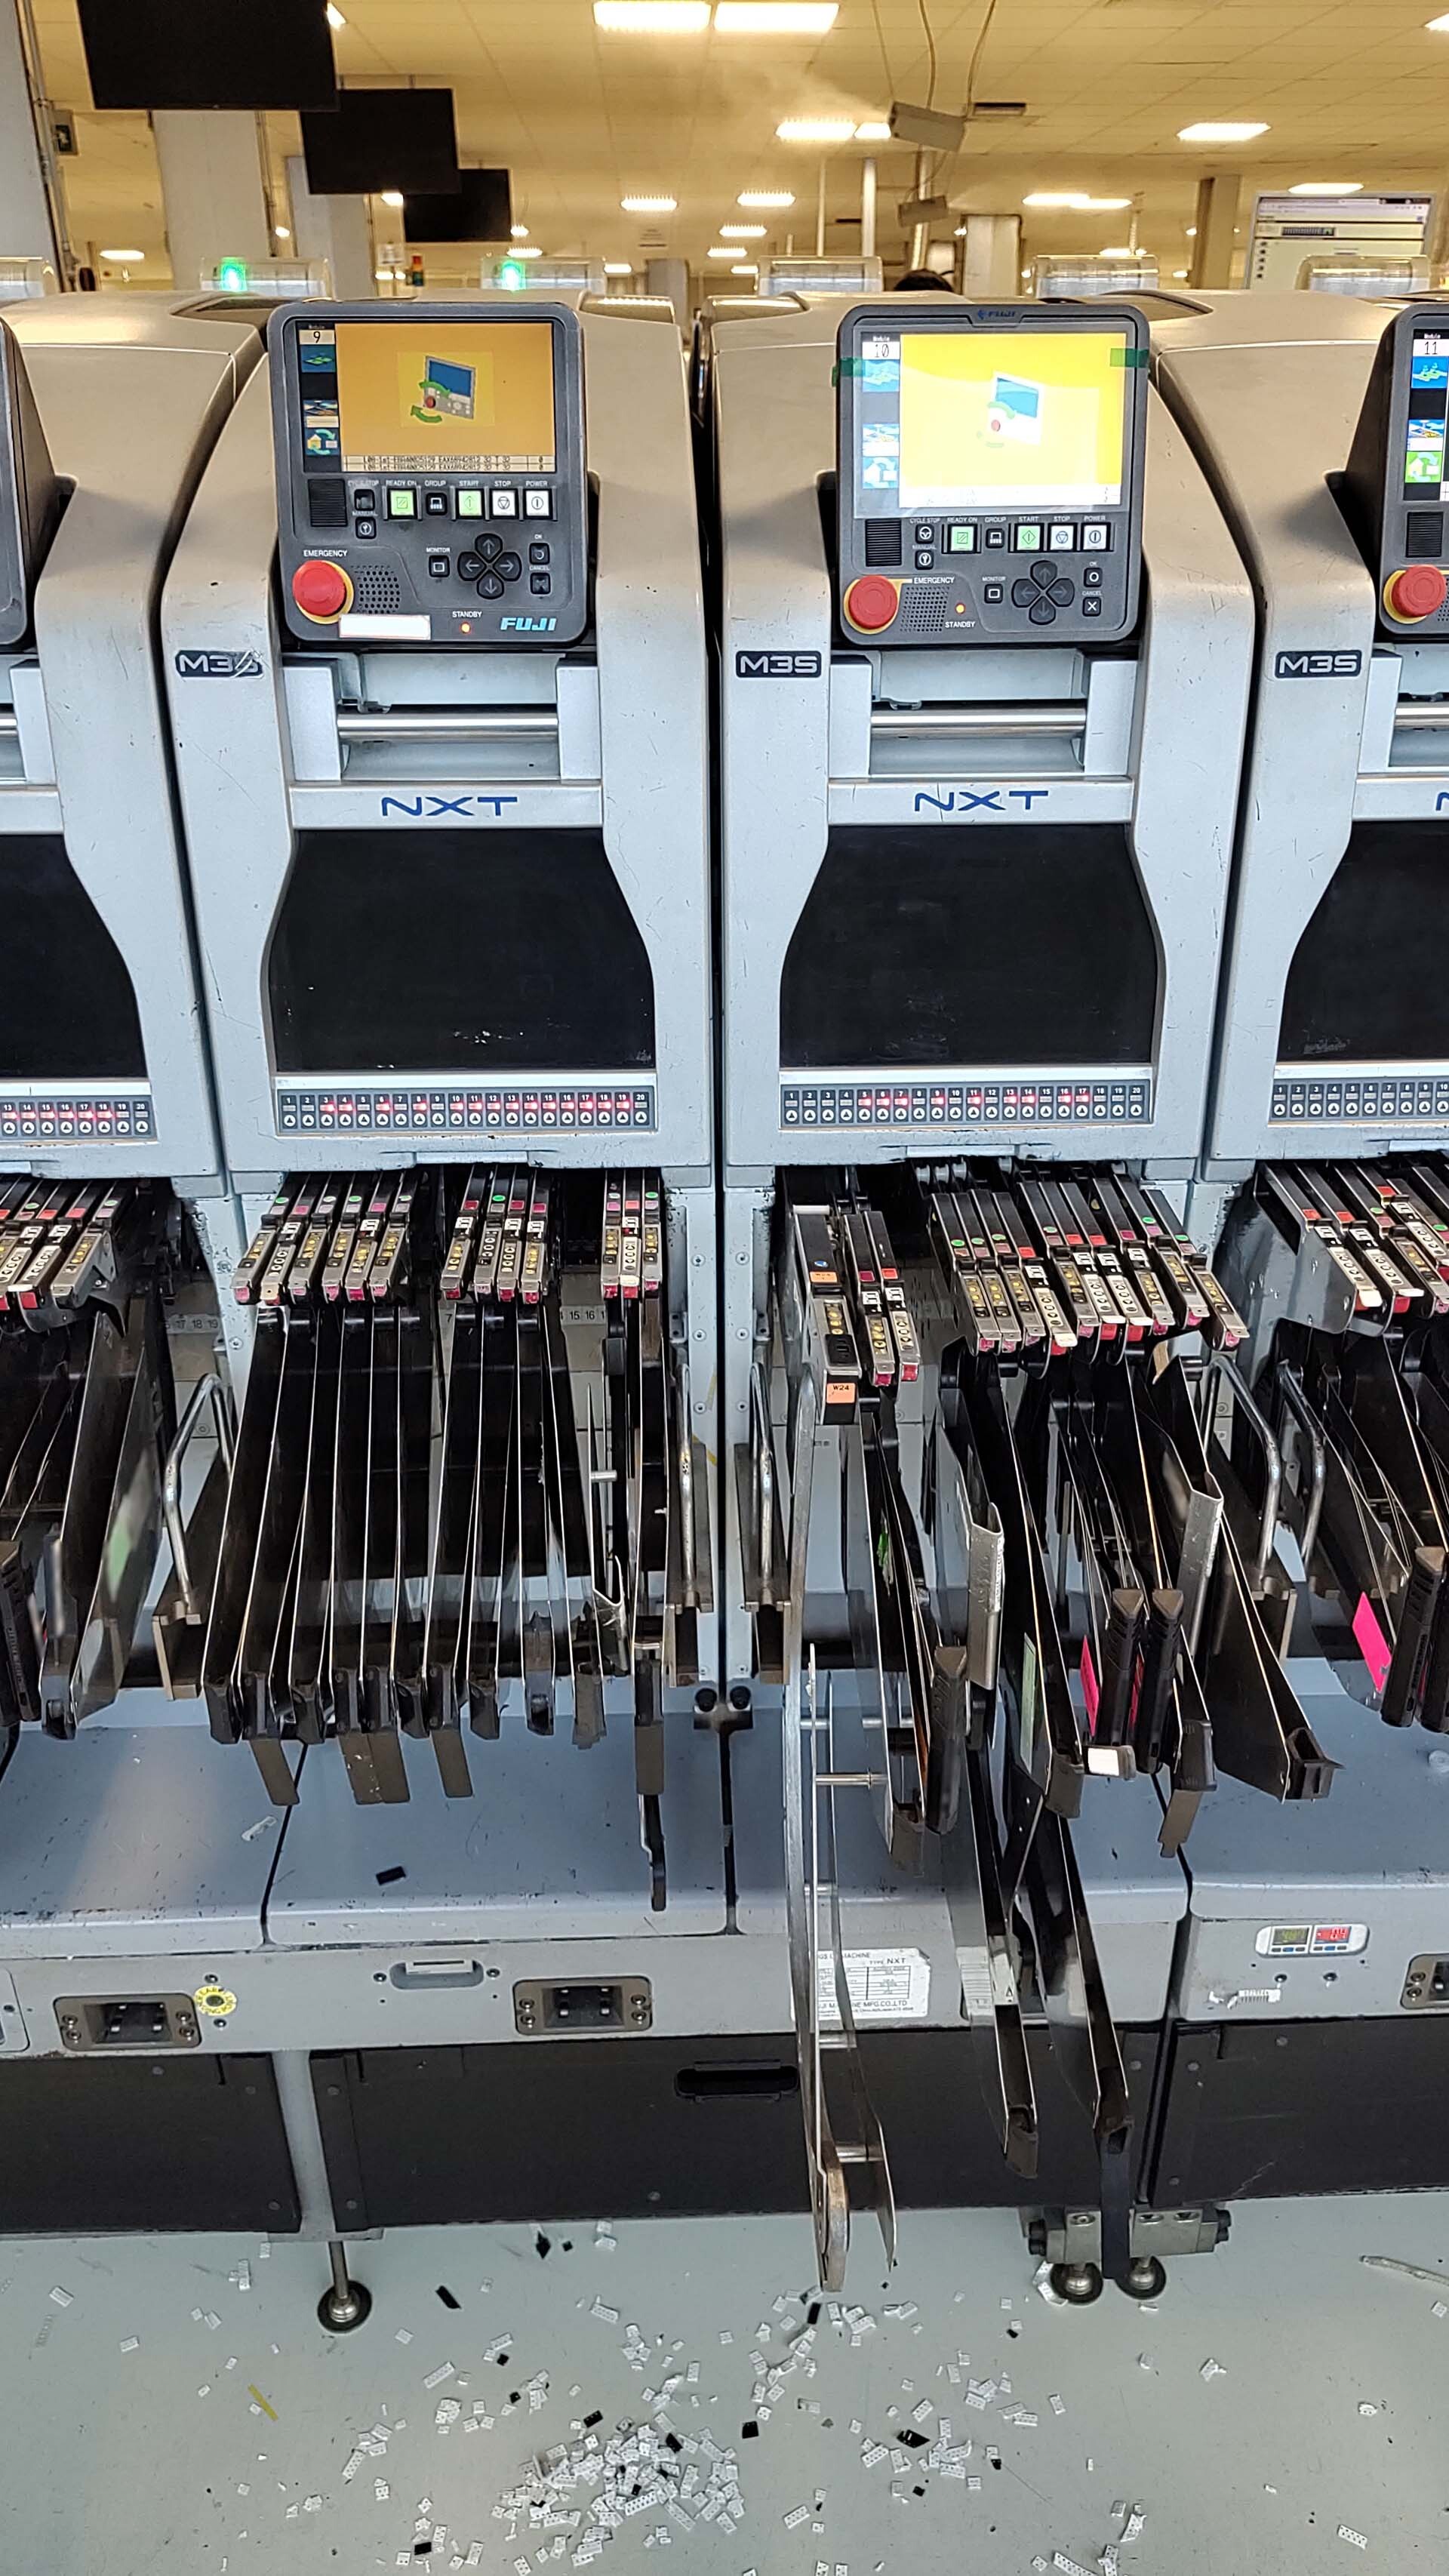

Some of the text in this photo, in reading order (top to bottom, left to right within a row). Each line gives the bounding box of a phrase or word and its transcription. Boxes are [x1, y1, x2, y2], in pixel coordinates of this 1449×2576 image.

[313, 331, 321, 343] 9
[875, 343, 890, 358] 10
[1424, 341, 1438, 355] 11
[500, 617, 557, 631] FUJI
[740, 655, 818, 674] M3S
[1279, 654, 1358, 674] M3S
[381, 796, 518, 817] NXT
[914, 790, 1049, 812] NXT
[570, 1310, 580, 1320] 15
[586, 1310, 595, 1319] 16
[192, 1319, 202, 1328] 18
[208, 1319, 218, 1328] 19
